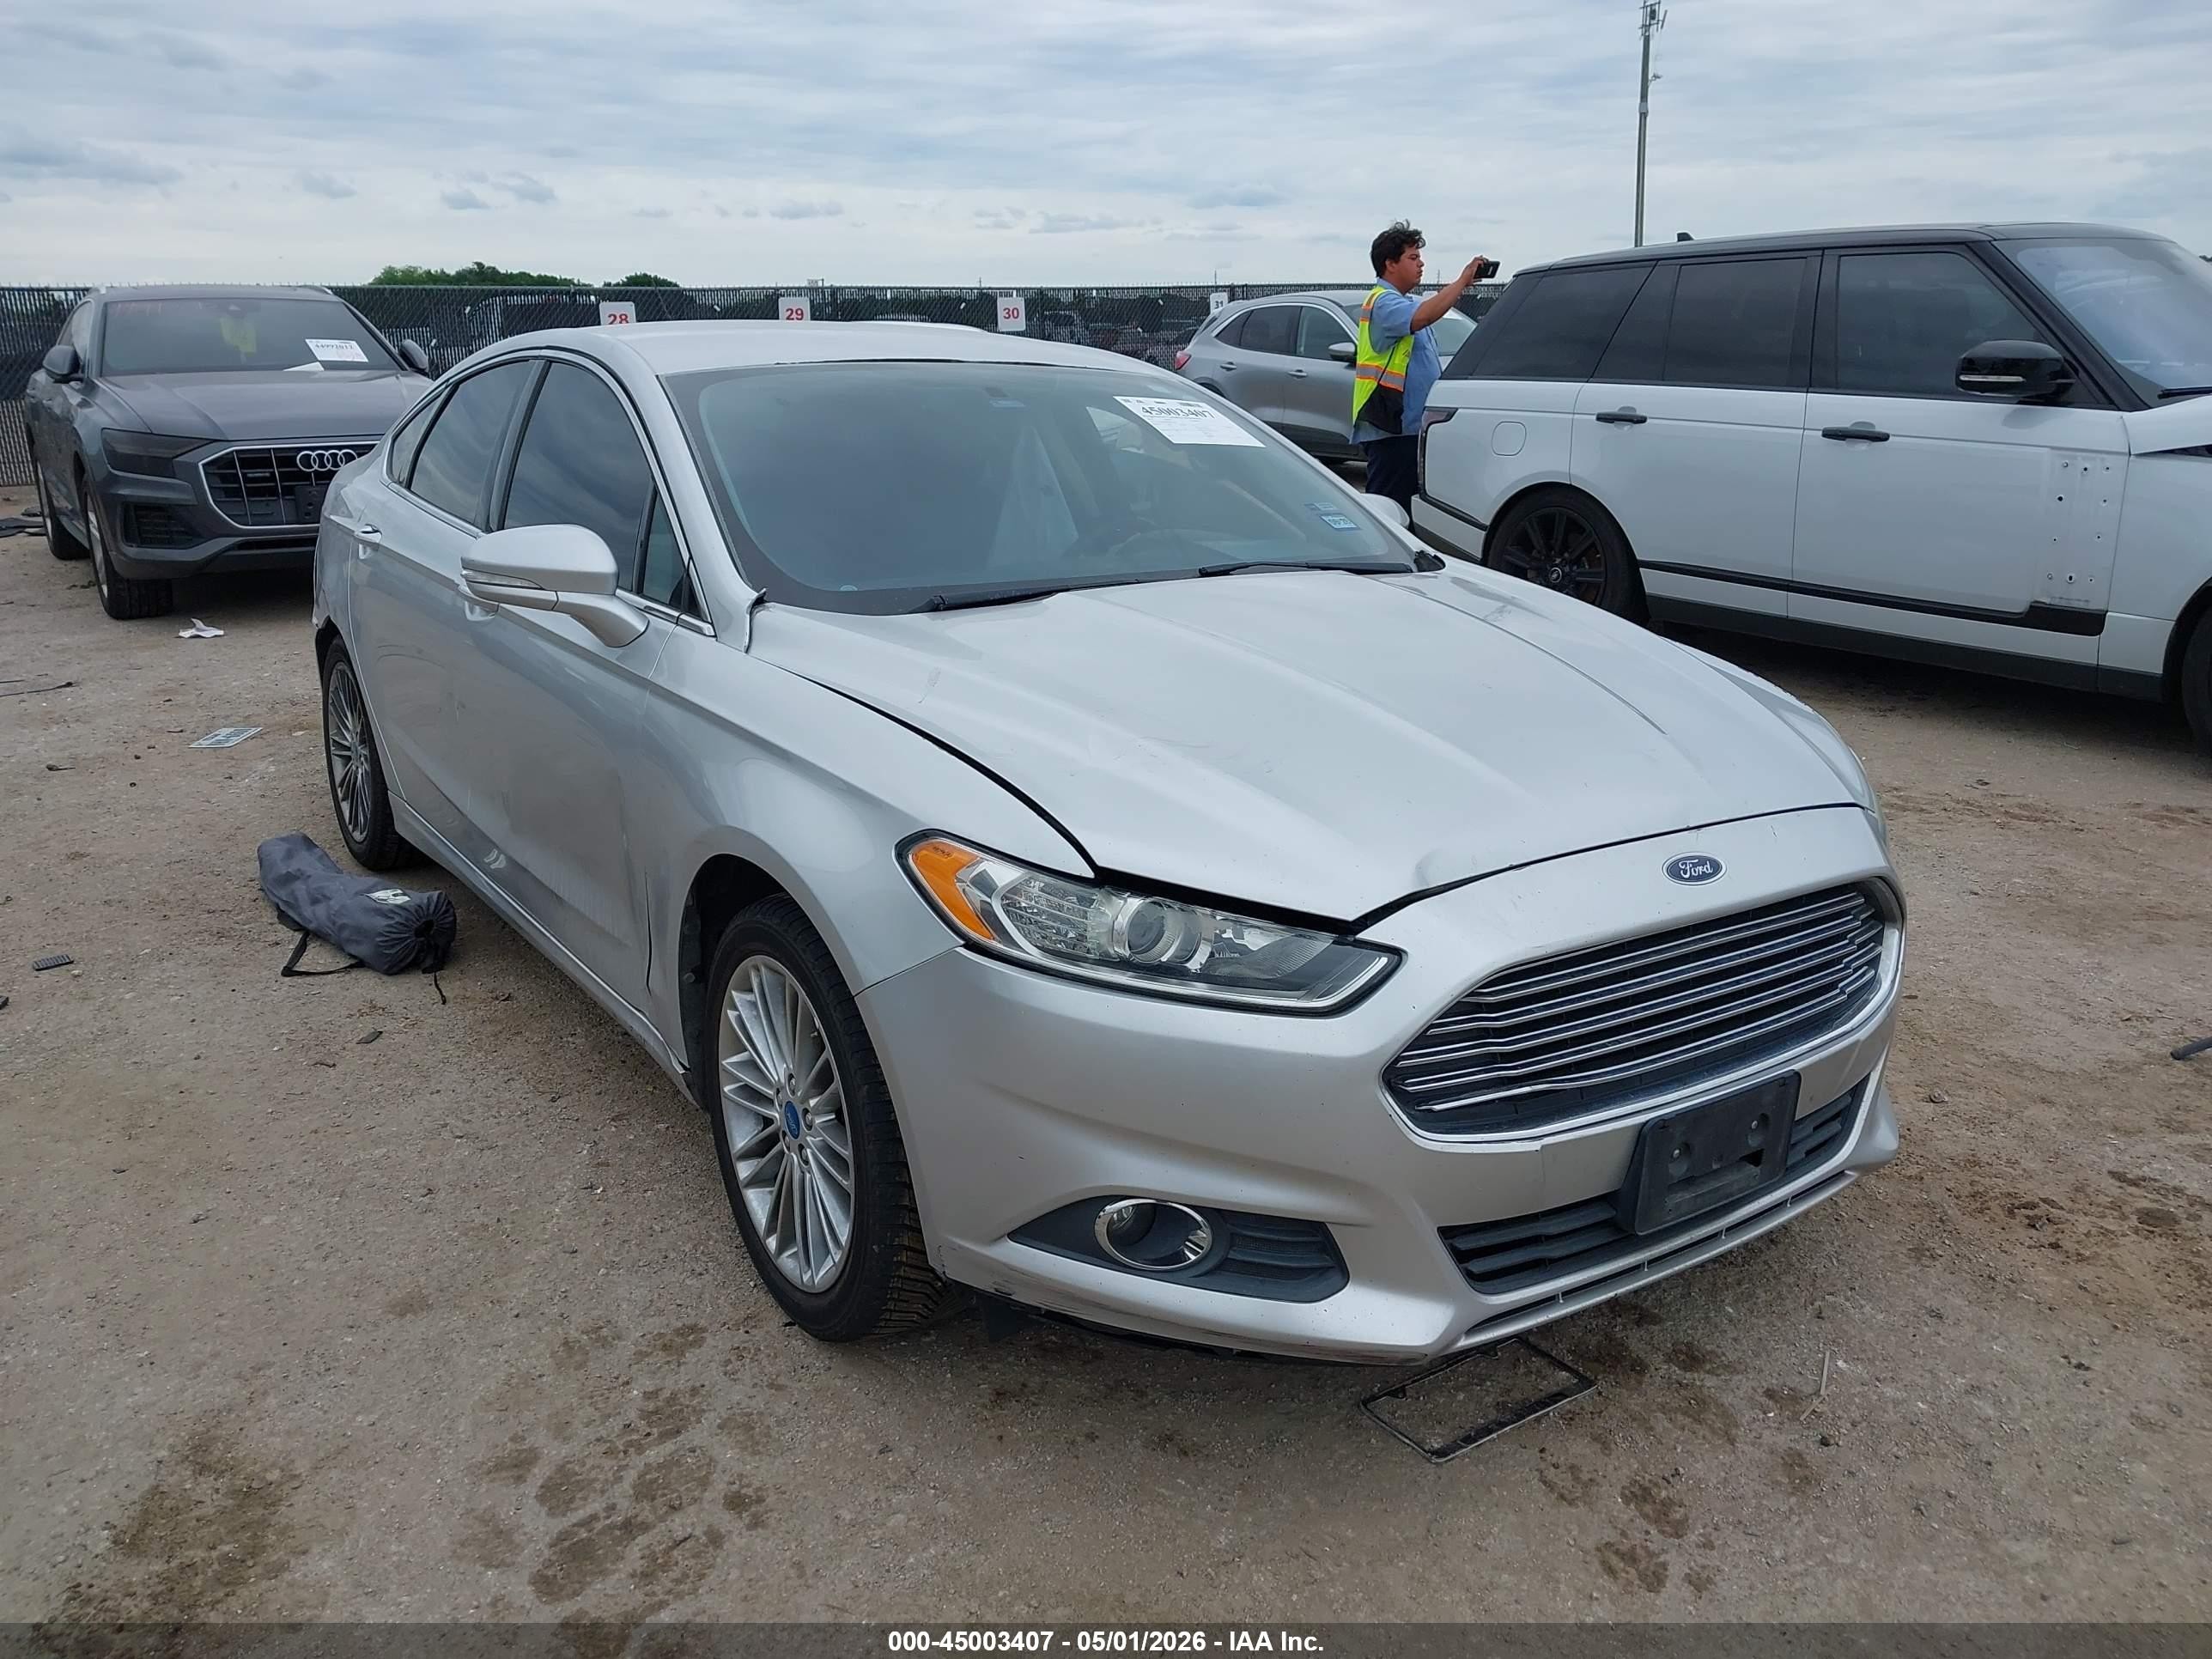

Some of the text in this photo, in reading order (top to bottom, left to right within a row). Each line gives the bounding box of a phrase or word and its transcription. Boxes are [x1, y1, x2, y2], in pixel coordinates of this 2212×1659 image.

[608, 313, 629, 325] 28
[786, 307, 804, 321] 29
[1003, 307, 1020, 320] 30
[1679, 859, 1713, 879] Ford
